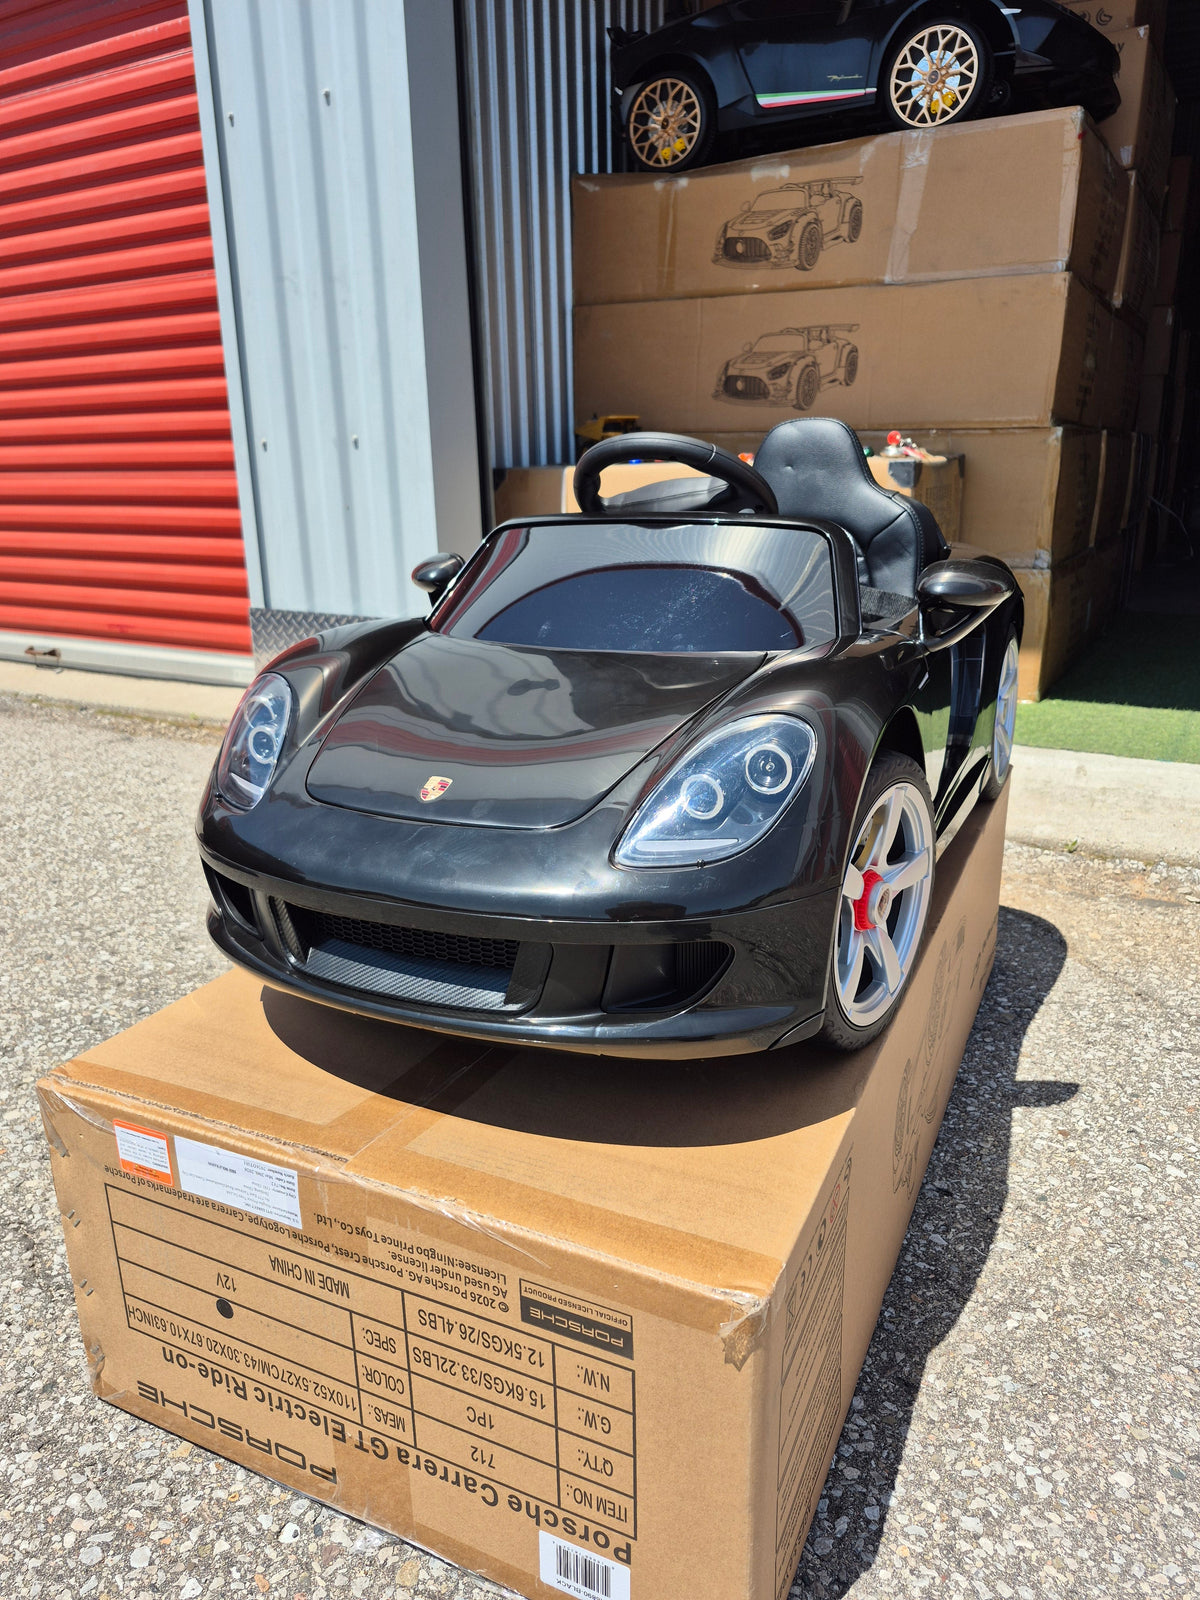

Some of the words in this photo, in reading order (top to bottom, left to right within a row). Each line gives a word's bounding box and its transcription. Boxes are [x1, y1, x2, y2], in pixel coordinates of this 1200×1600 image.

[104, 1164, 136, 1184] Porsche
[136, 1177, 146, 1188] of
[146, 1178, 195, 1204] trademarks
[196, 1197, 210, 1208] are
[211, 1202, 244, 1222] Carrera
[312, 1212, 332, 1228] Ltd.
[244, 1212, 290, 1238] Logotype,
[334, 1218, 354, 1234] Co.,
[355, 1226, 379, 1244] Toys
[292, 1230, 330, 1252] Porsche
[331, 1242, 360, 1264] Crest,
[380, 1234, 413, 1256] Prince
[268, 1254, 302, 1280] CHINA
[362, 1255, 403, 1278] Porsche
[388, 1250, 428, 1274] license.
[416, 1246, 506, 1286] Licensee:Ningbo
[430, 1264, 462, 1282] under
[216, 1272, 236, 1293] 12V
[304, 1268, 315, 1286] IN
[318, 1272, 350, 1299] MADE
[406, 1269, 422, 1283] AG.
[424, 1276, 467, 1300] Porsche
[464, 1275, 490, 1291] used
[469, 1291, 496, 1309] 2026
[492, 1285, 508, 1299] AG
[523, 1286, 557, 1302] PRODUCT
[558, 1298, 594, 1314] LICENSED
[594, 1309, 628, 1327] OFFICIAL
[417, 1308, 544, 1368] 12.5KGS/26.4LBS
[530, 1306, 624, 1348] PORSCHE
[362, 1328, 396, 1354] SPEC:
[127, 1304, 357, 1412] 110X52.5X27CM/43.30X20.67X10.63INCH
[162, 1346, 246, 1400] Ride-on
[362, 1364, 404, 1394] COLOR:
[412, 1346, 546, 1410] 15.6KGS/33.22LBS
[576, 1365, 610, 1392] N.W.:
[254, 1386, 346, 1443] Electric
[368, 1404, 406, 1432] MEAS.:
[466, 1406, 494, 1430] 1PC
[578, 1408, 611, 1434] G.W.:
[136, 1380, 337, 1484] PORSCHE
[354, 1430, 389, 1460] GT
[470, 1446, 496, 1469] 712
[578, 1449, 614, 1477] Q'TY.:
[396, 1447, 498, 1507] Carrera
[566, 1484, 592, 1510] NO.:
[596, 1496, 628, 1523] ITEM
[507, 1494, 632, 1566] Porsche
